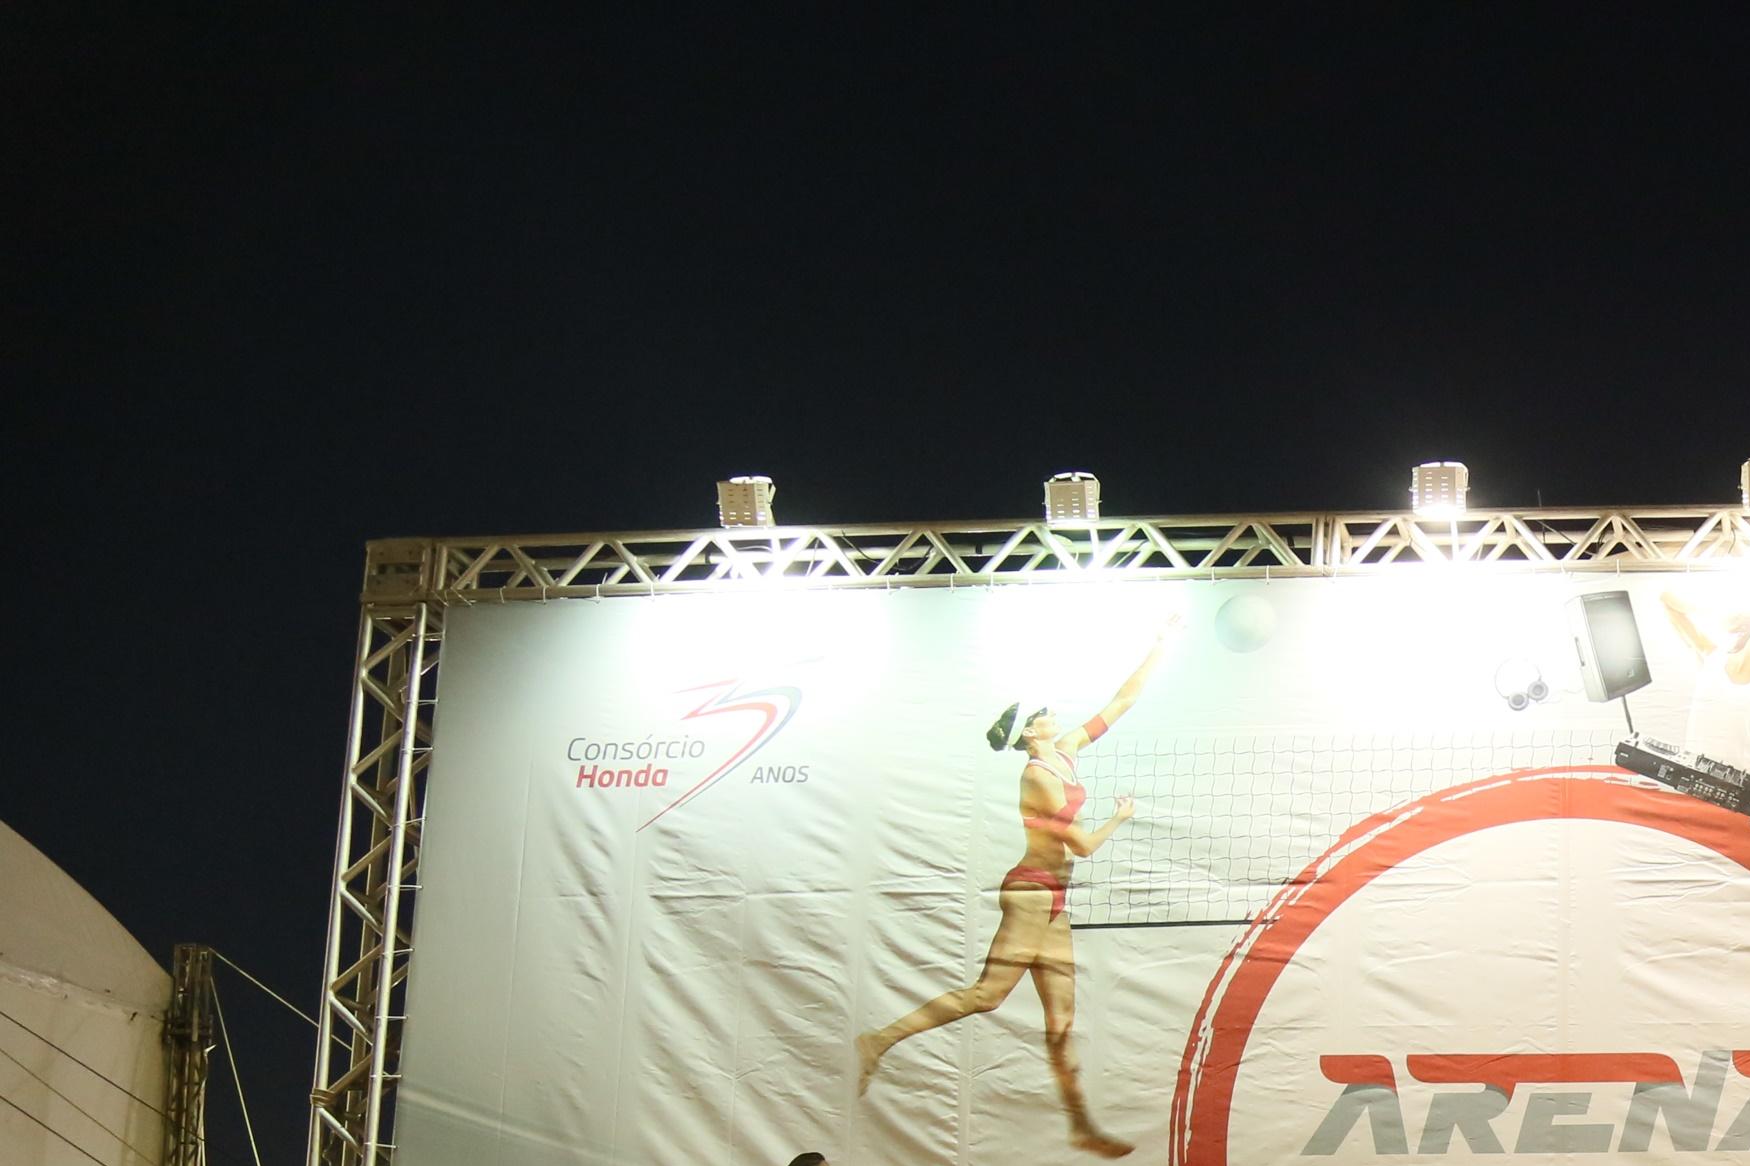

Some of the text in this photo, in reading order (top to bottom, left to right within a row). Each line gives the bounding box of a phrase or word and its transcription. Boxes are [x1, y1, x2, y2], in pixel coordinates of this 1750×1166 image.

[567, 734, 705, 761] Consórcio
[576, 763, 669, 788] Honda
[750, 765, 810, 784] ANOS
